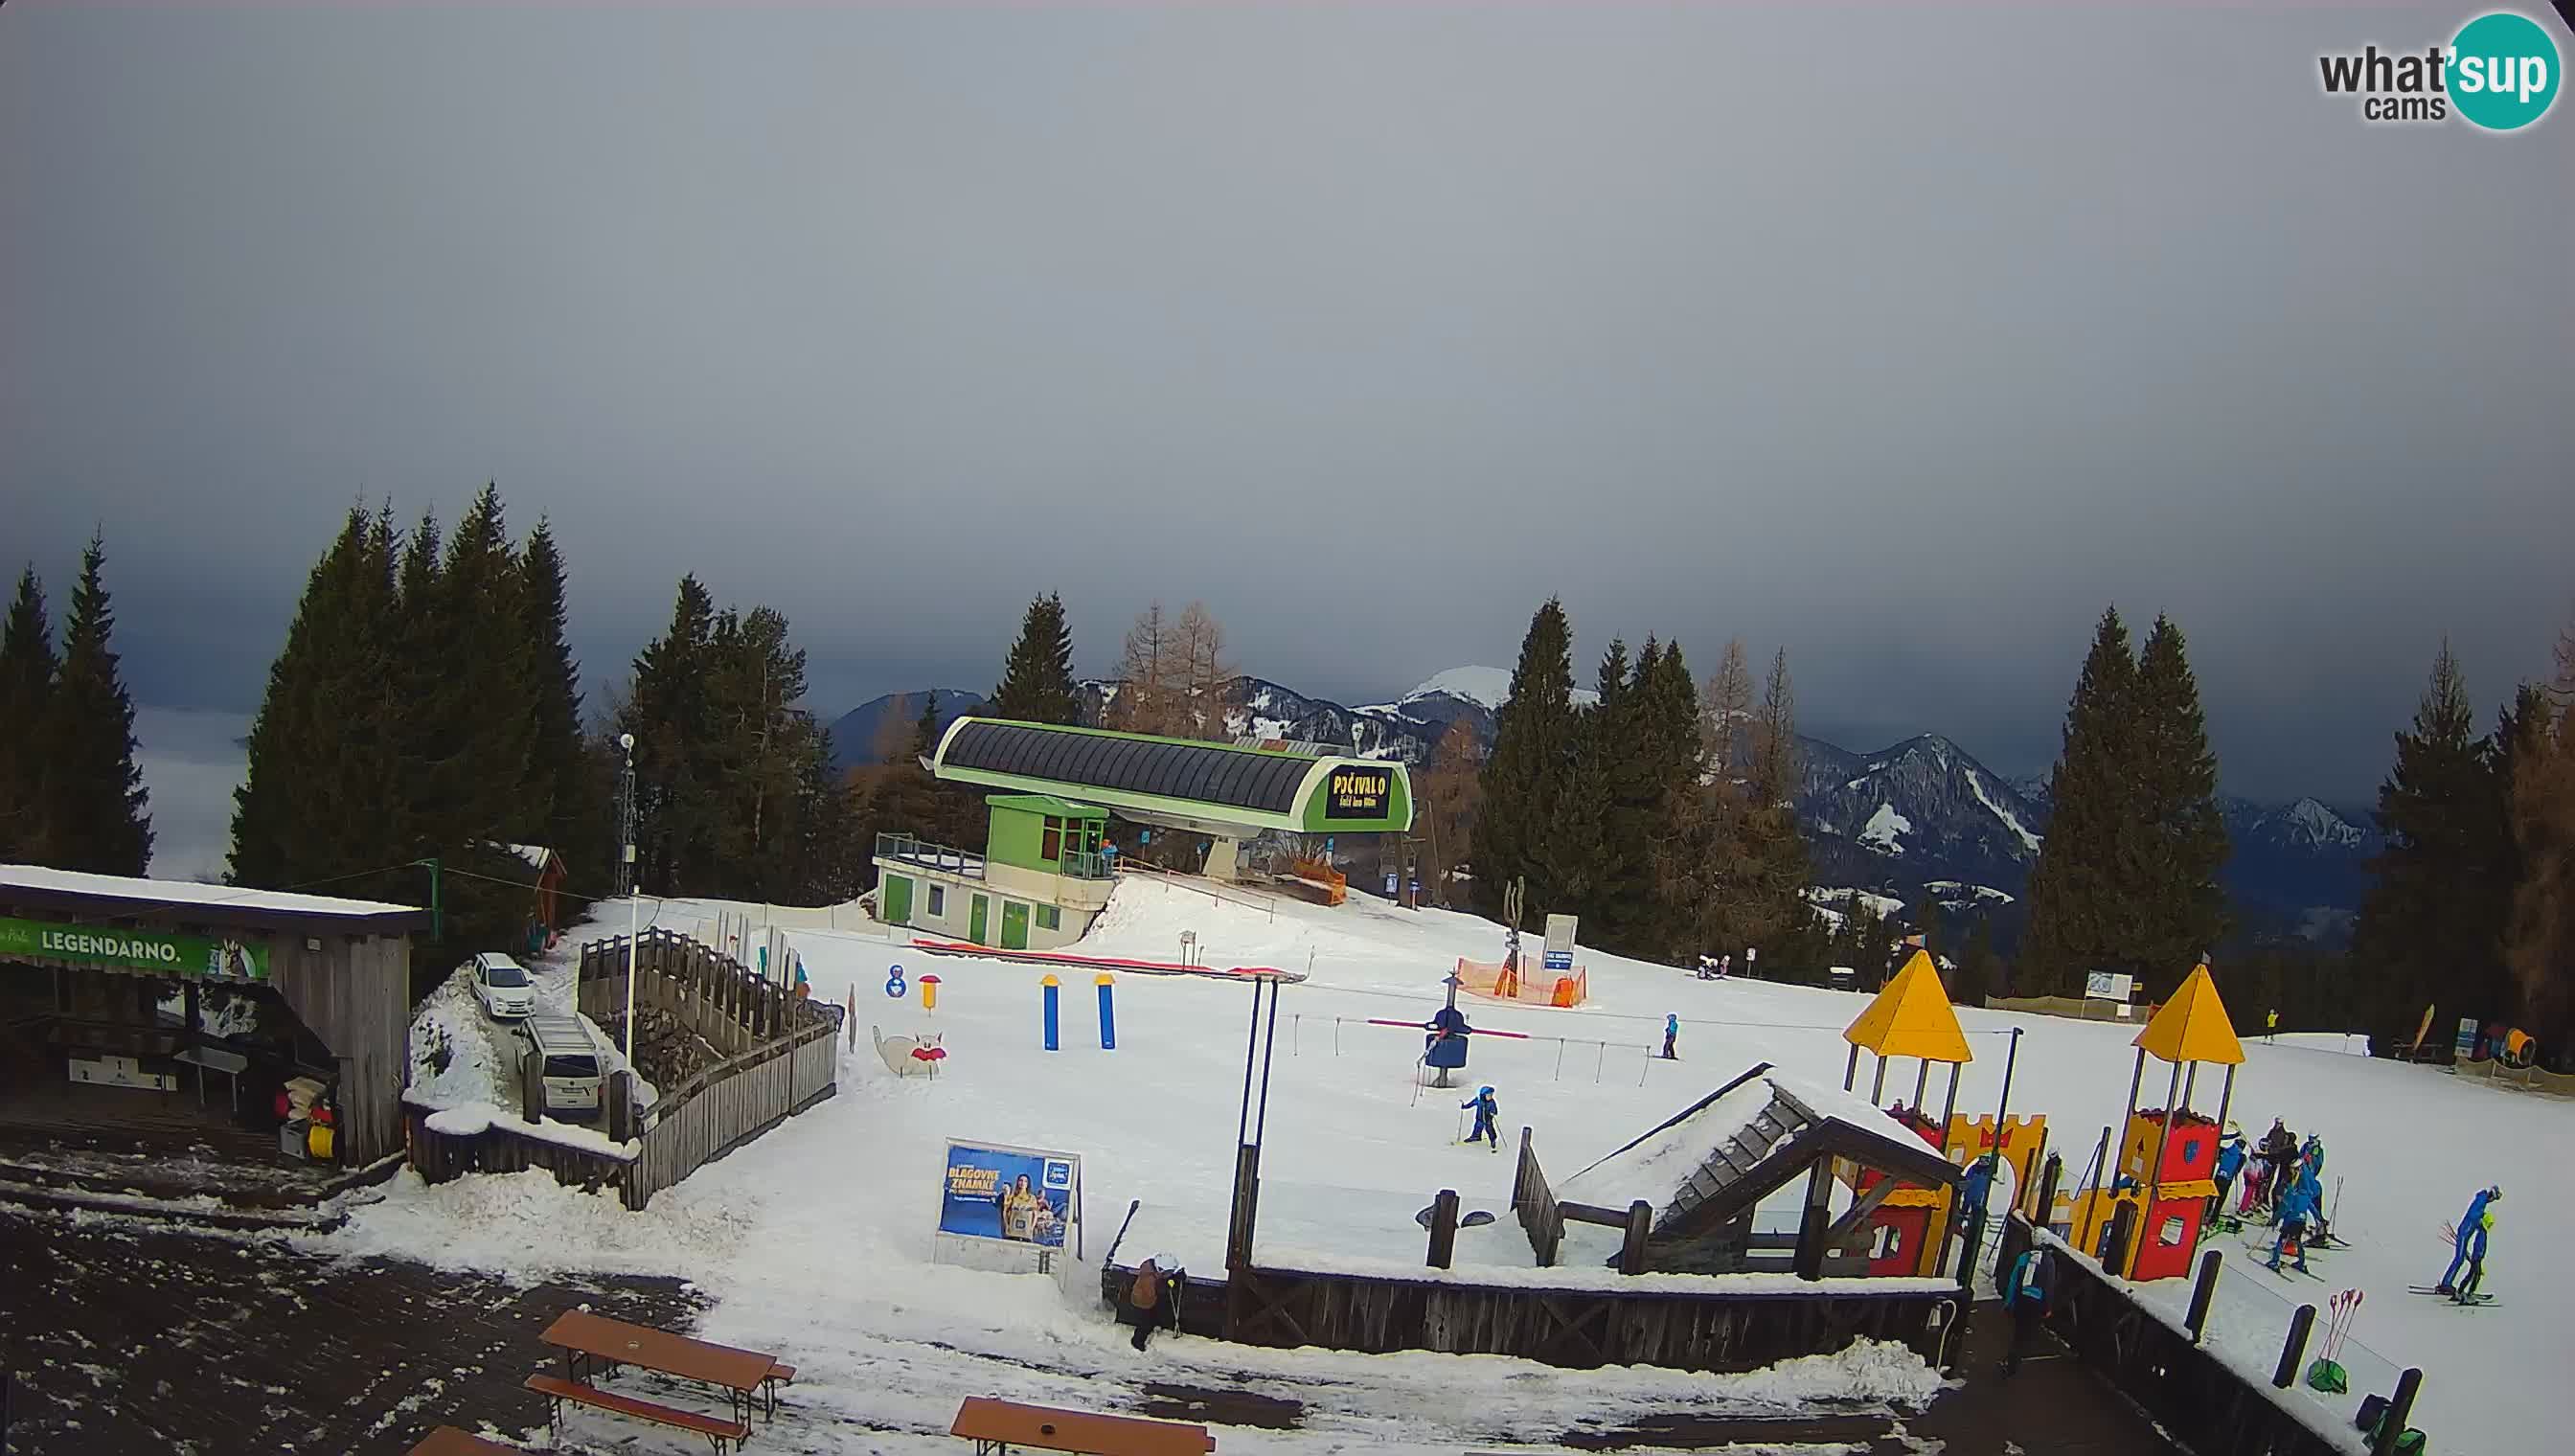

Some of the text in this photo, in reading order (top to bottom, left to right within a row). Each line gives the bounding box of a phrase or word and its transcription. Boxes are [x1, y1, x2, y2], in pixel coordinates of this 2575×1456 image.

[42, 931, 181, 963] LEGENDARNO.
[948, 1168, 1000, 1180] BLAGOVNE
[951, 1178, 995, 1190] ZNAMKE
